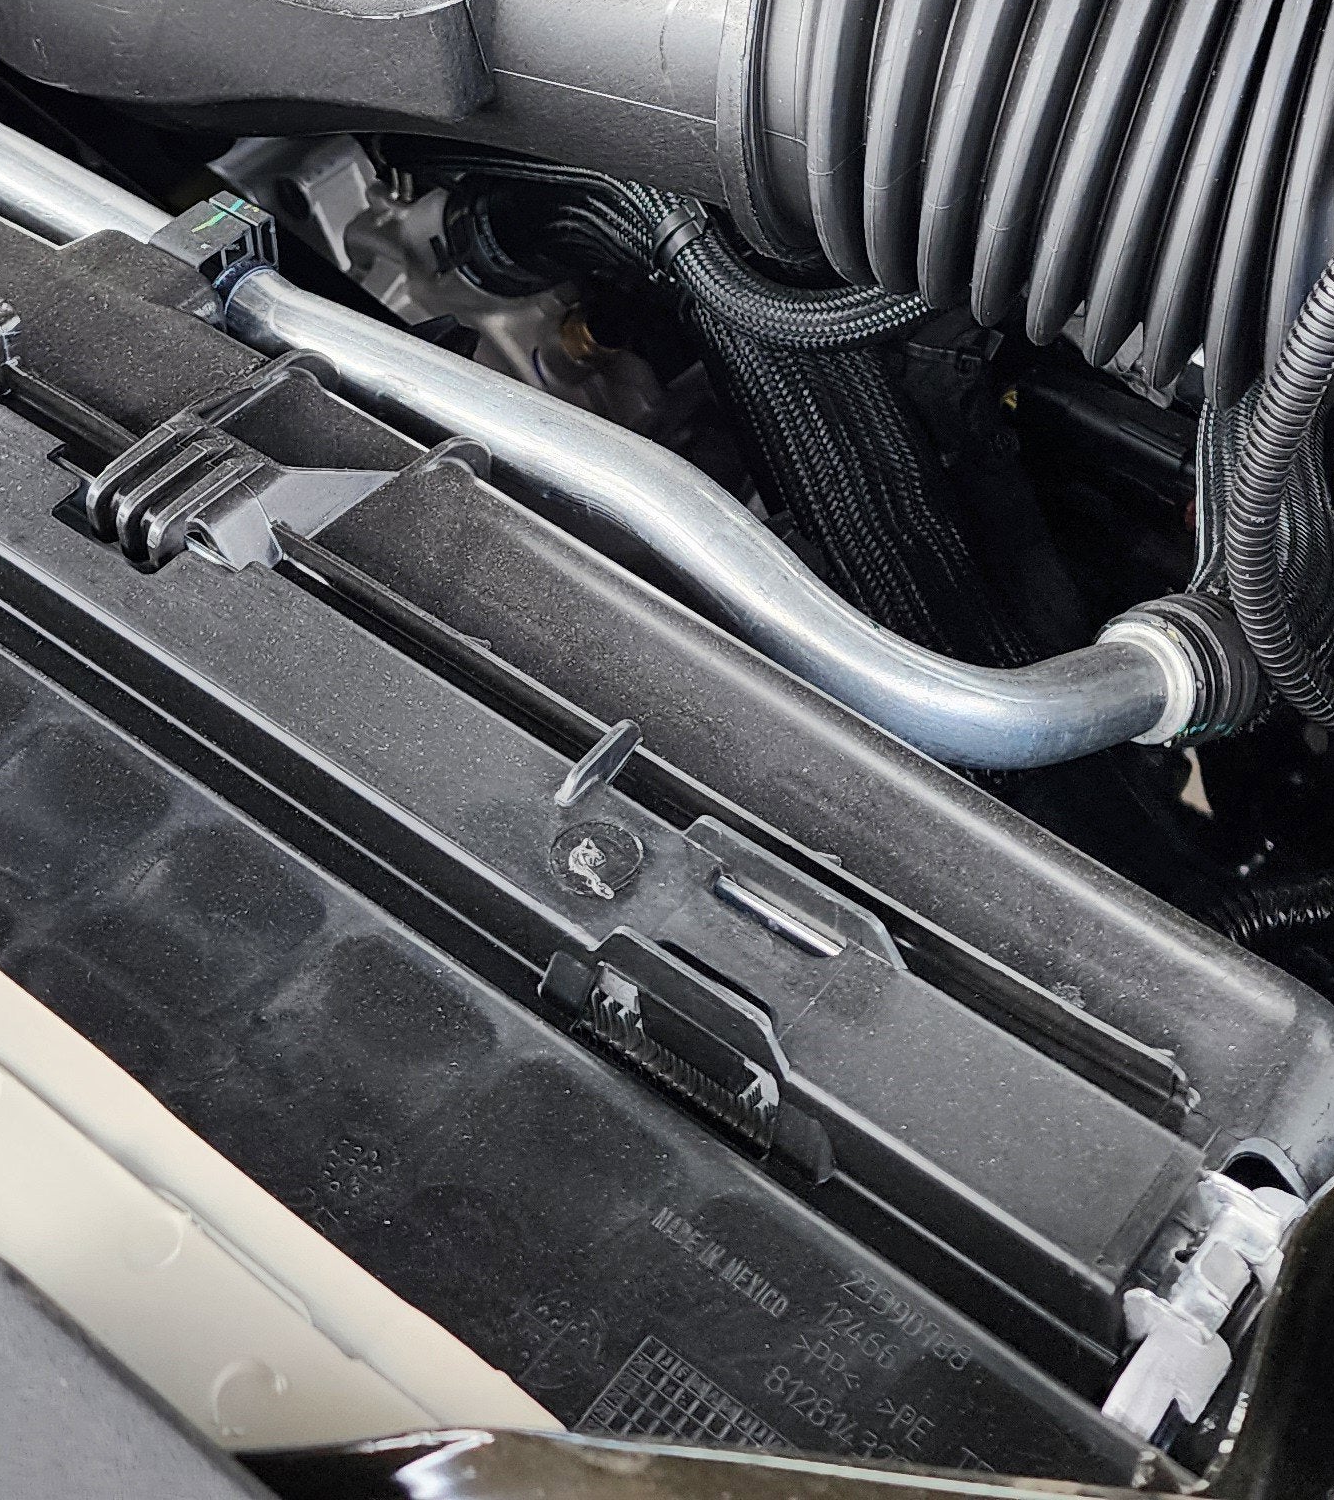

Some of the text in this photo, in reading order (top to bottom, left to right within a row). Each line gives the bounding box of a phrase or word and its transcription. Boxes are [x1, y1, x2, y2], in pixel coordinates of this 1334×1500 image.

[651, 1206, 789, 1318] MADE IN MEXICO
